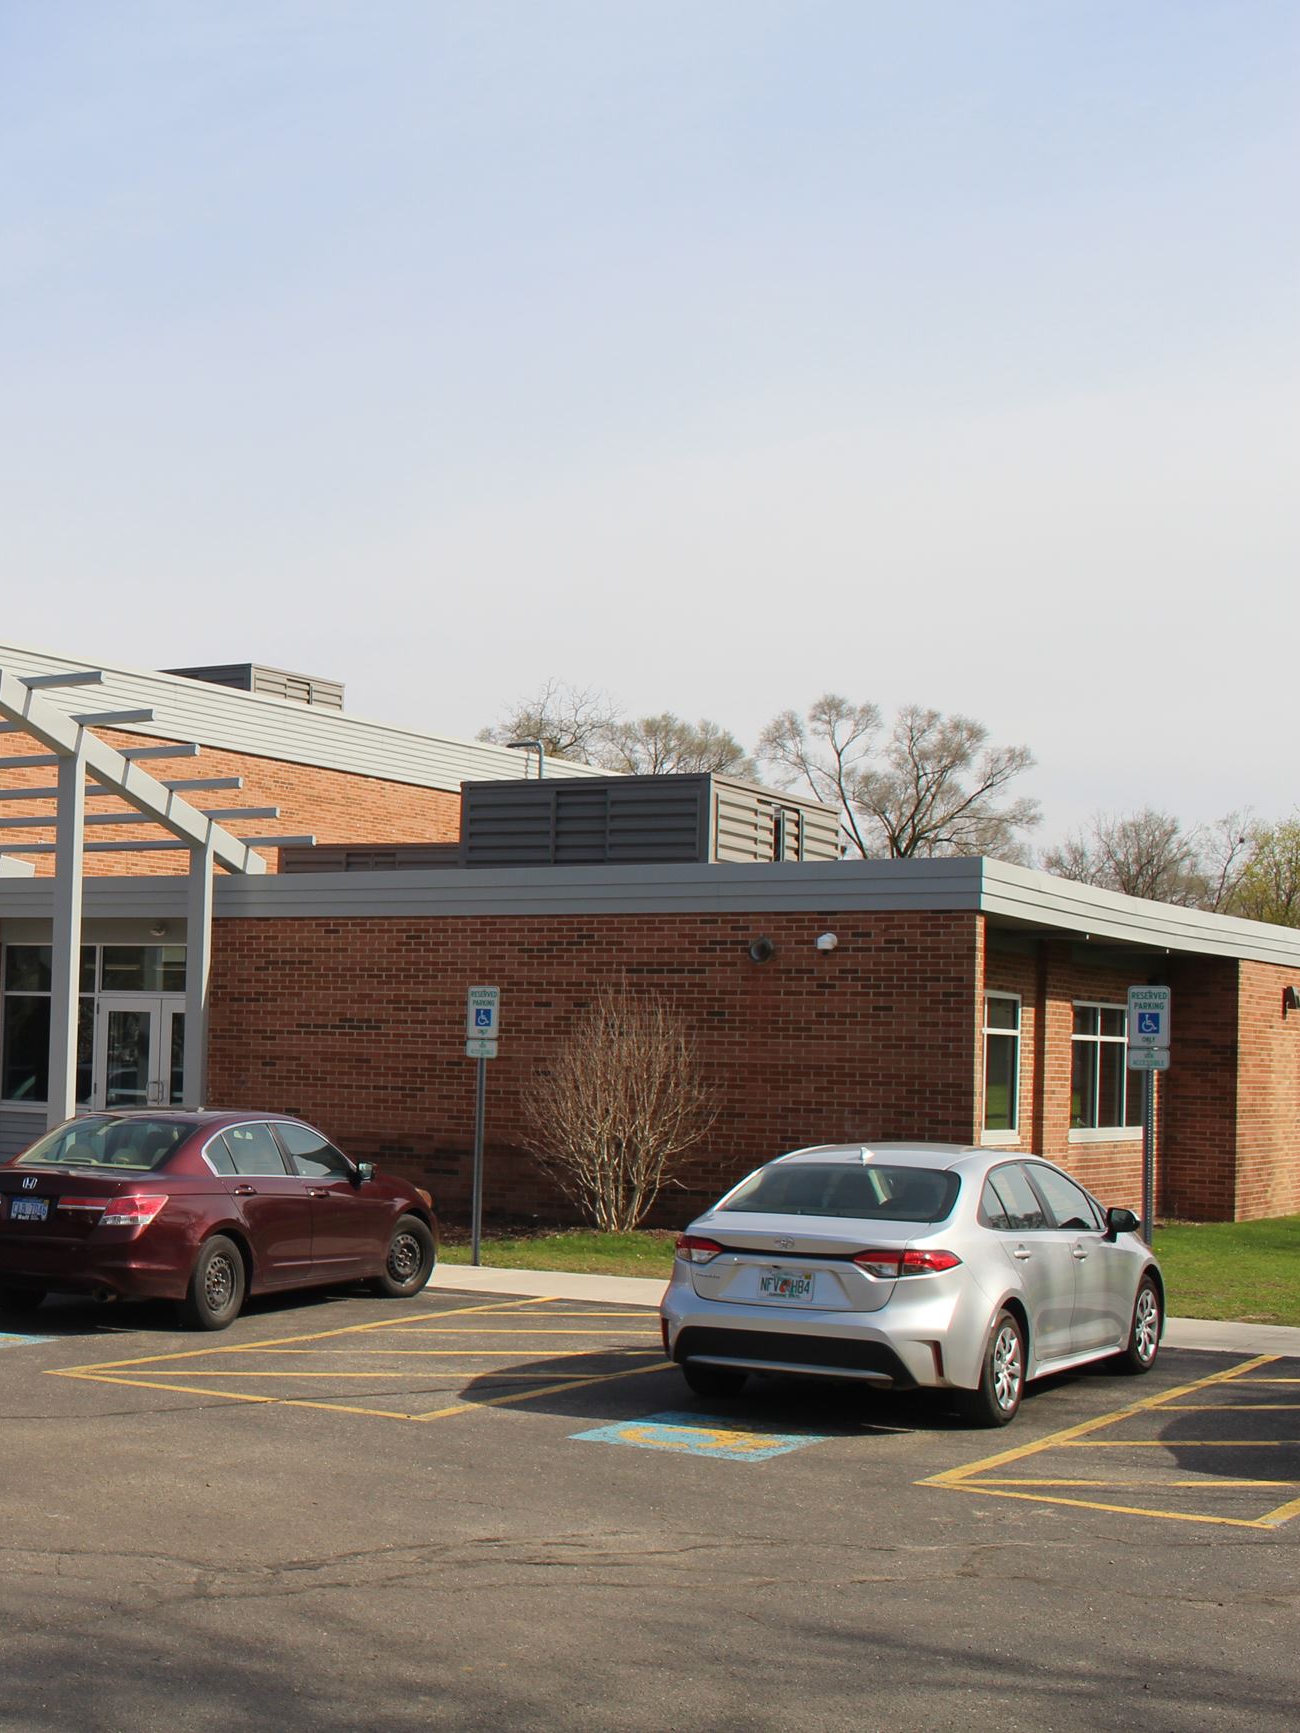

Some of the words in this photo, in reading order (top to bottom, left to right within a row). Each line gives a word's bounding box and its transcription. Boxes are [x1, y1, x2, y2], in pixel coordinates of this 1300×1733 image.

[1131, 991, 1167, 1000] RESERVED
[472, 999, 495, 1007] PARKING
[1134, 1002, 1164, 1010] PARKING
[760, 1277, 780, 1292] NFV
